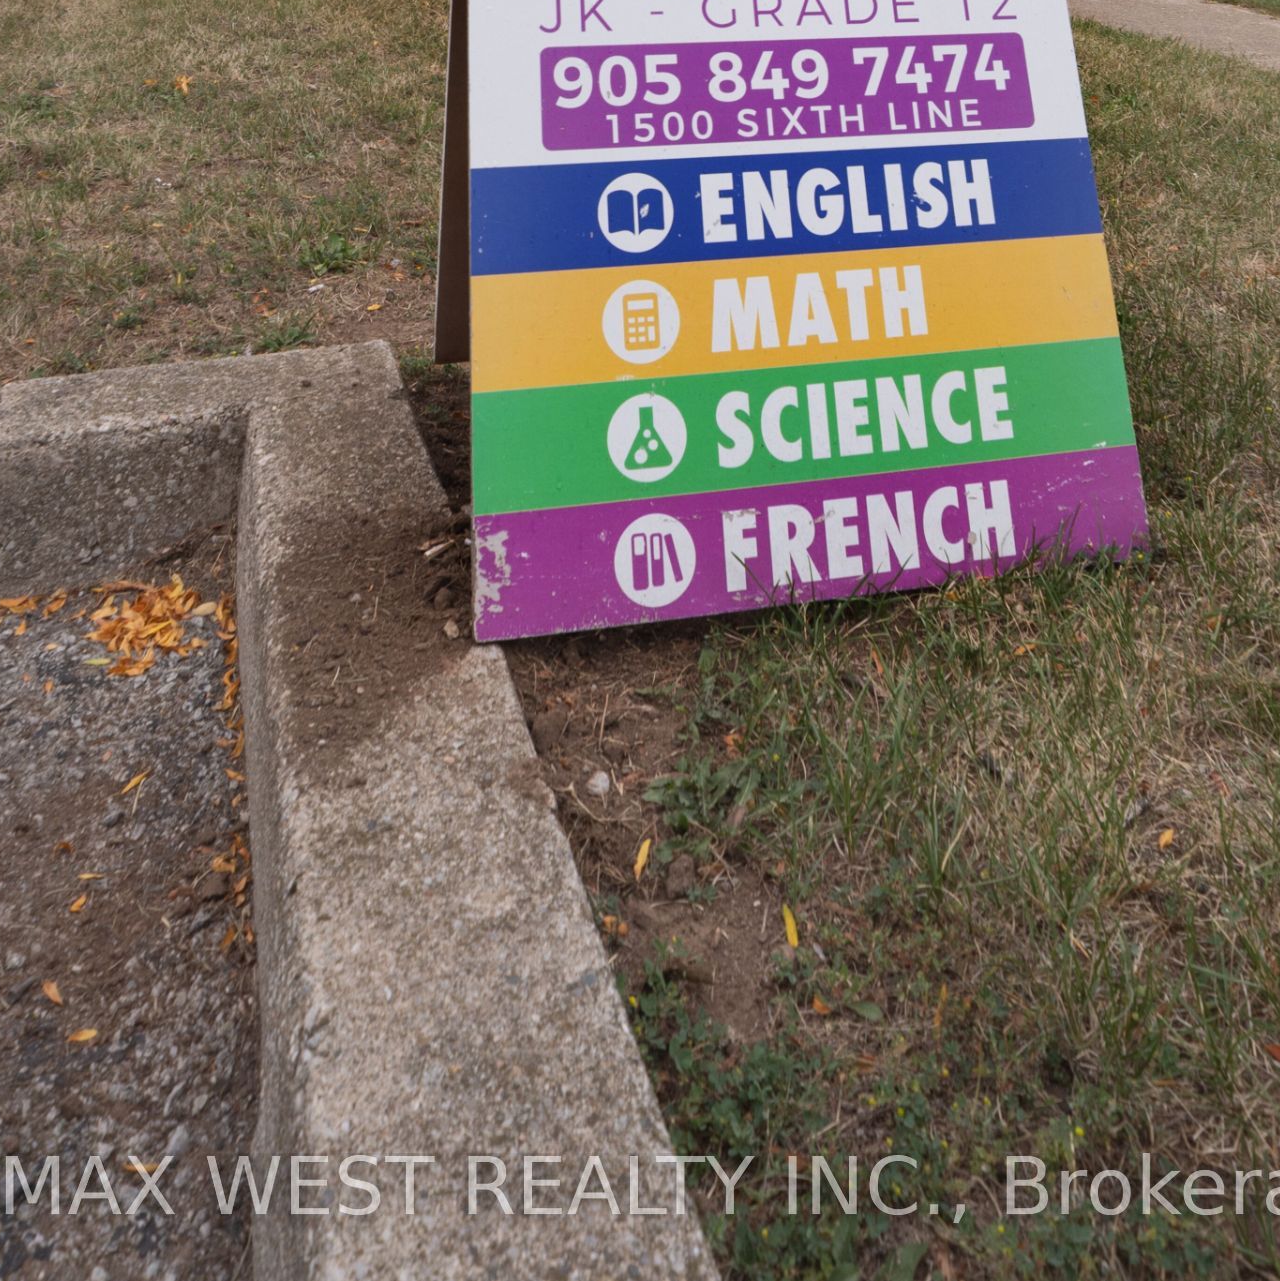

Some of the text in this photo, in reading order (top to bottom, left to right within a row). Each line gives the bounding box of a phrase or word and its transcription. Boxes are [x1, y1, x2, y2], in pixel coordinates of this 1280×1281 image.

[553, 42, 1010, 109] 905 849 7474
[606, 98, 982, 144] 1500 SIXTH LINE
[699, 158, 996, 243] ENGLISH
[711, 265, 928, 353] MATH
[716, 366, 1014, 469] SCIENCE
[723, 479, 1016, 593] FRENCH
